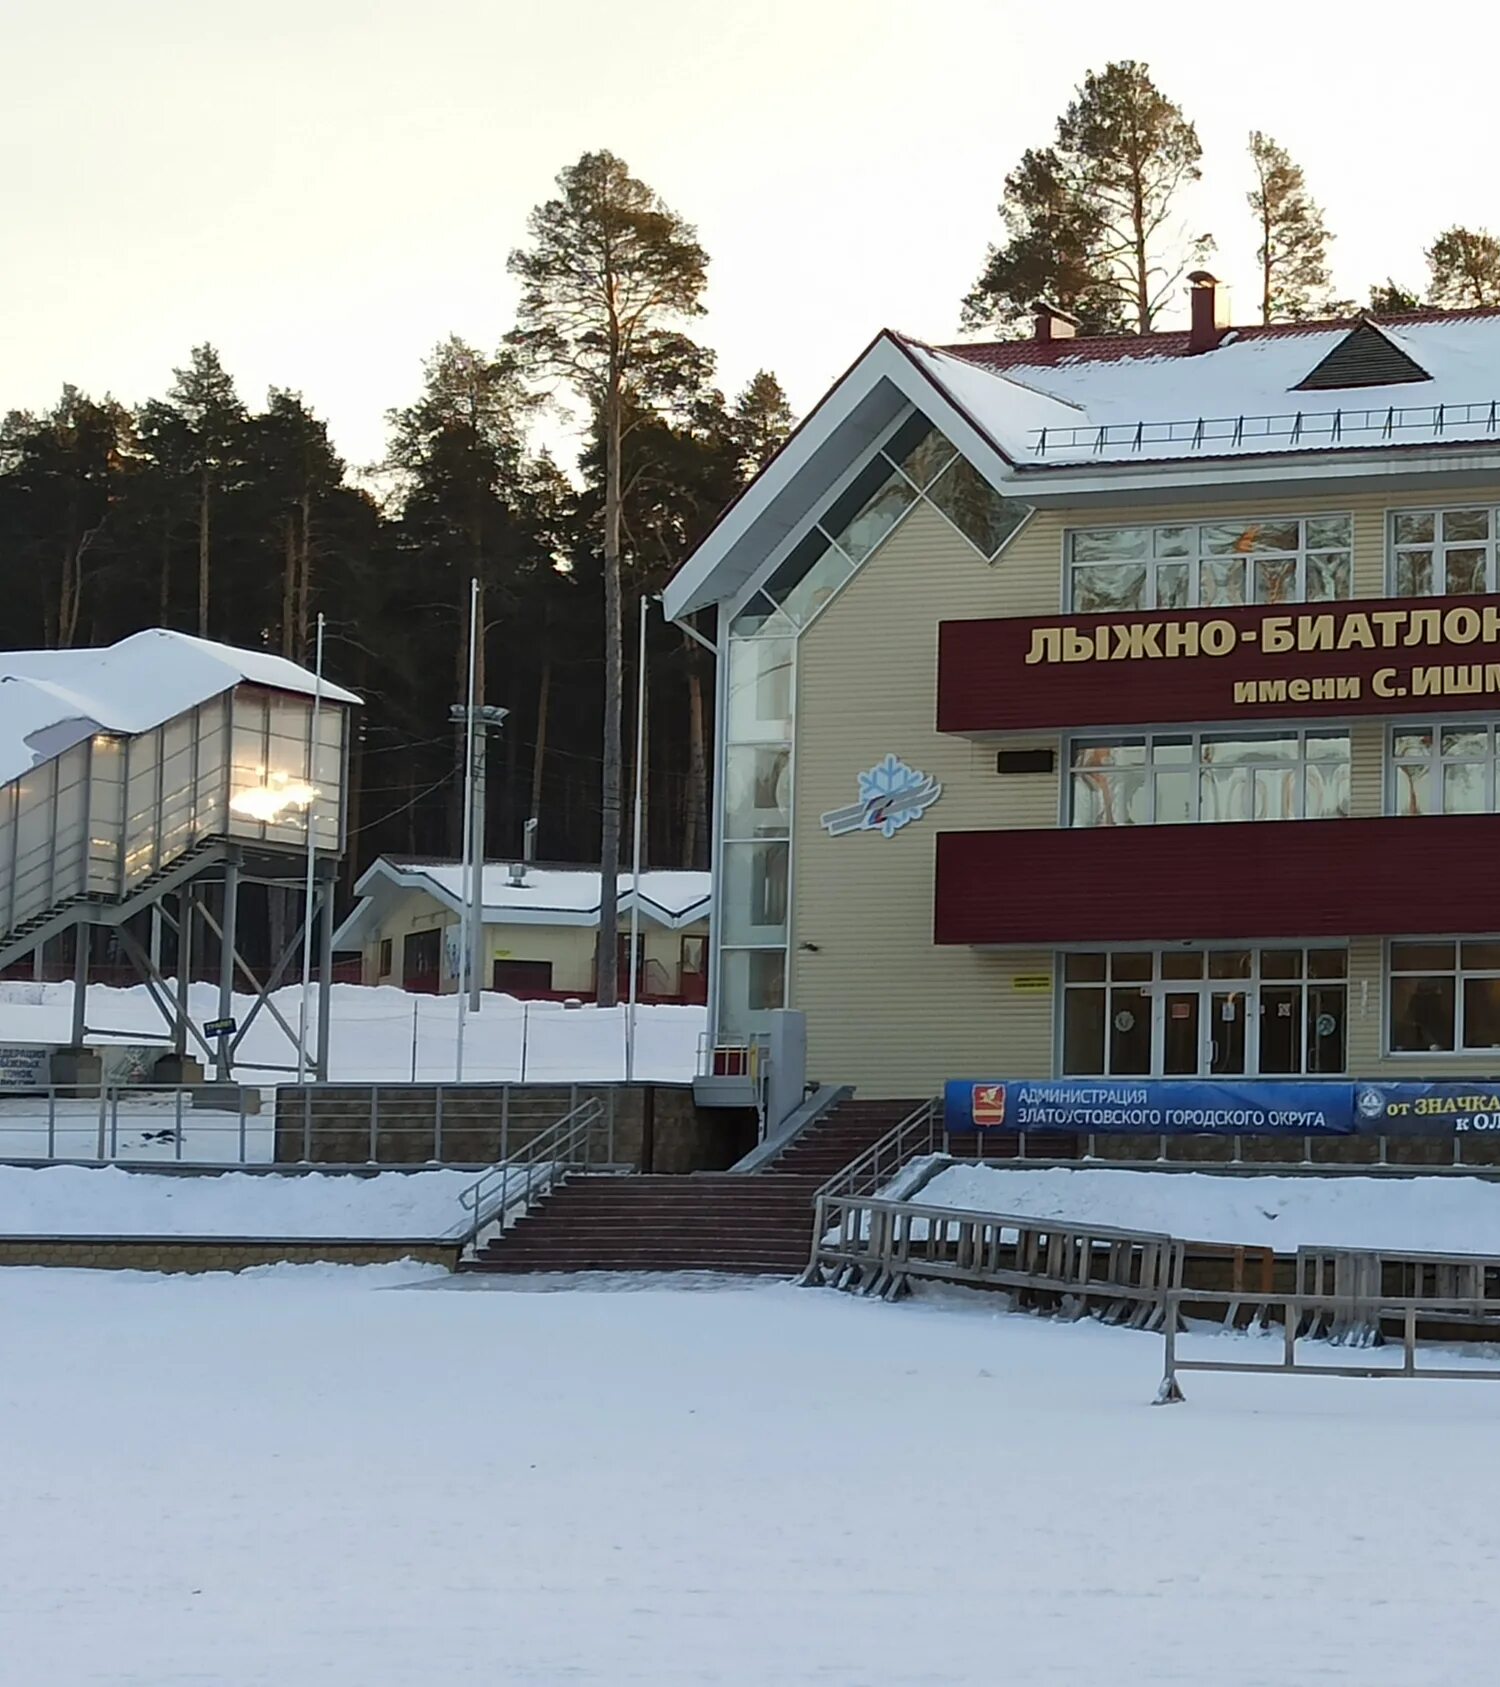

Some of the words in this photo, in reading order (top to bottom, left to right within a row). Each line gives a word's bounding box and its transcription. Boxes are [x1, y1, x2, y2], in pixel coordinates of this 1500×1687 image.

[1233, 677, 1361, 704] имени
[1017, 1088, 1147, 1105] АДМИНИСТРАЦИЯ
[1387, 1102, 1410, 1117] от
[1415, 1094, 1500, 1116] ЗНАЧКА
[1017, 1108, 1160, 1125] ЗЛАТОУСТОВСКОГО
[1165, 1109, 1263, 1127] ГОРОДСКОГО
[1268, 1110, 1325, 1128] ОКРУГА
